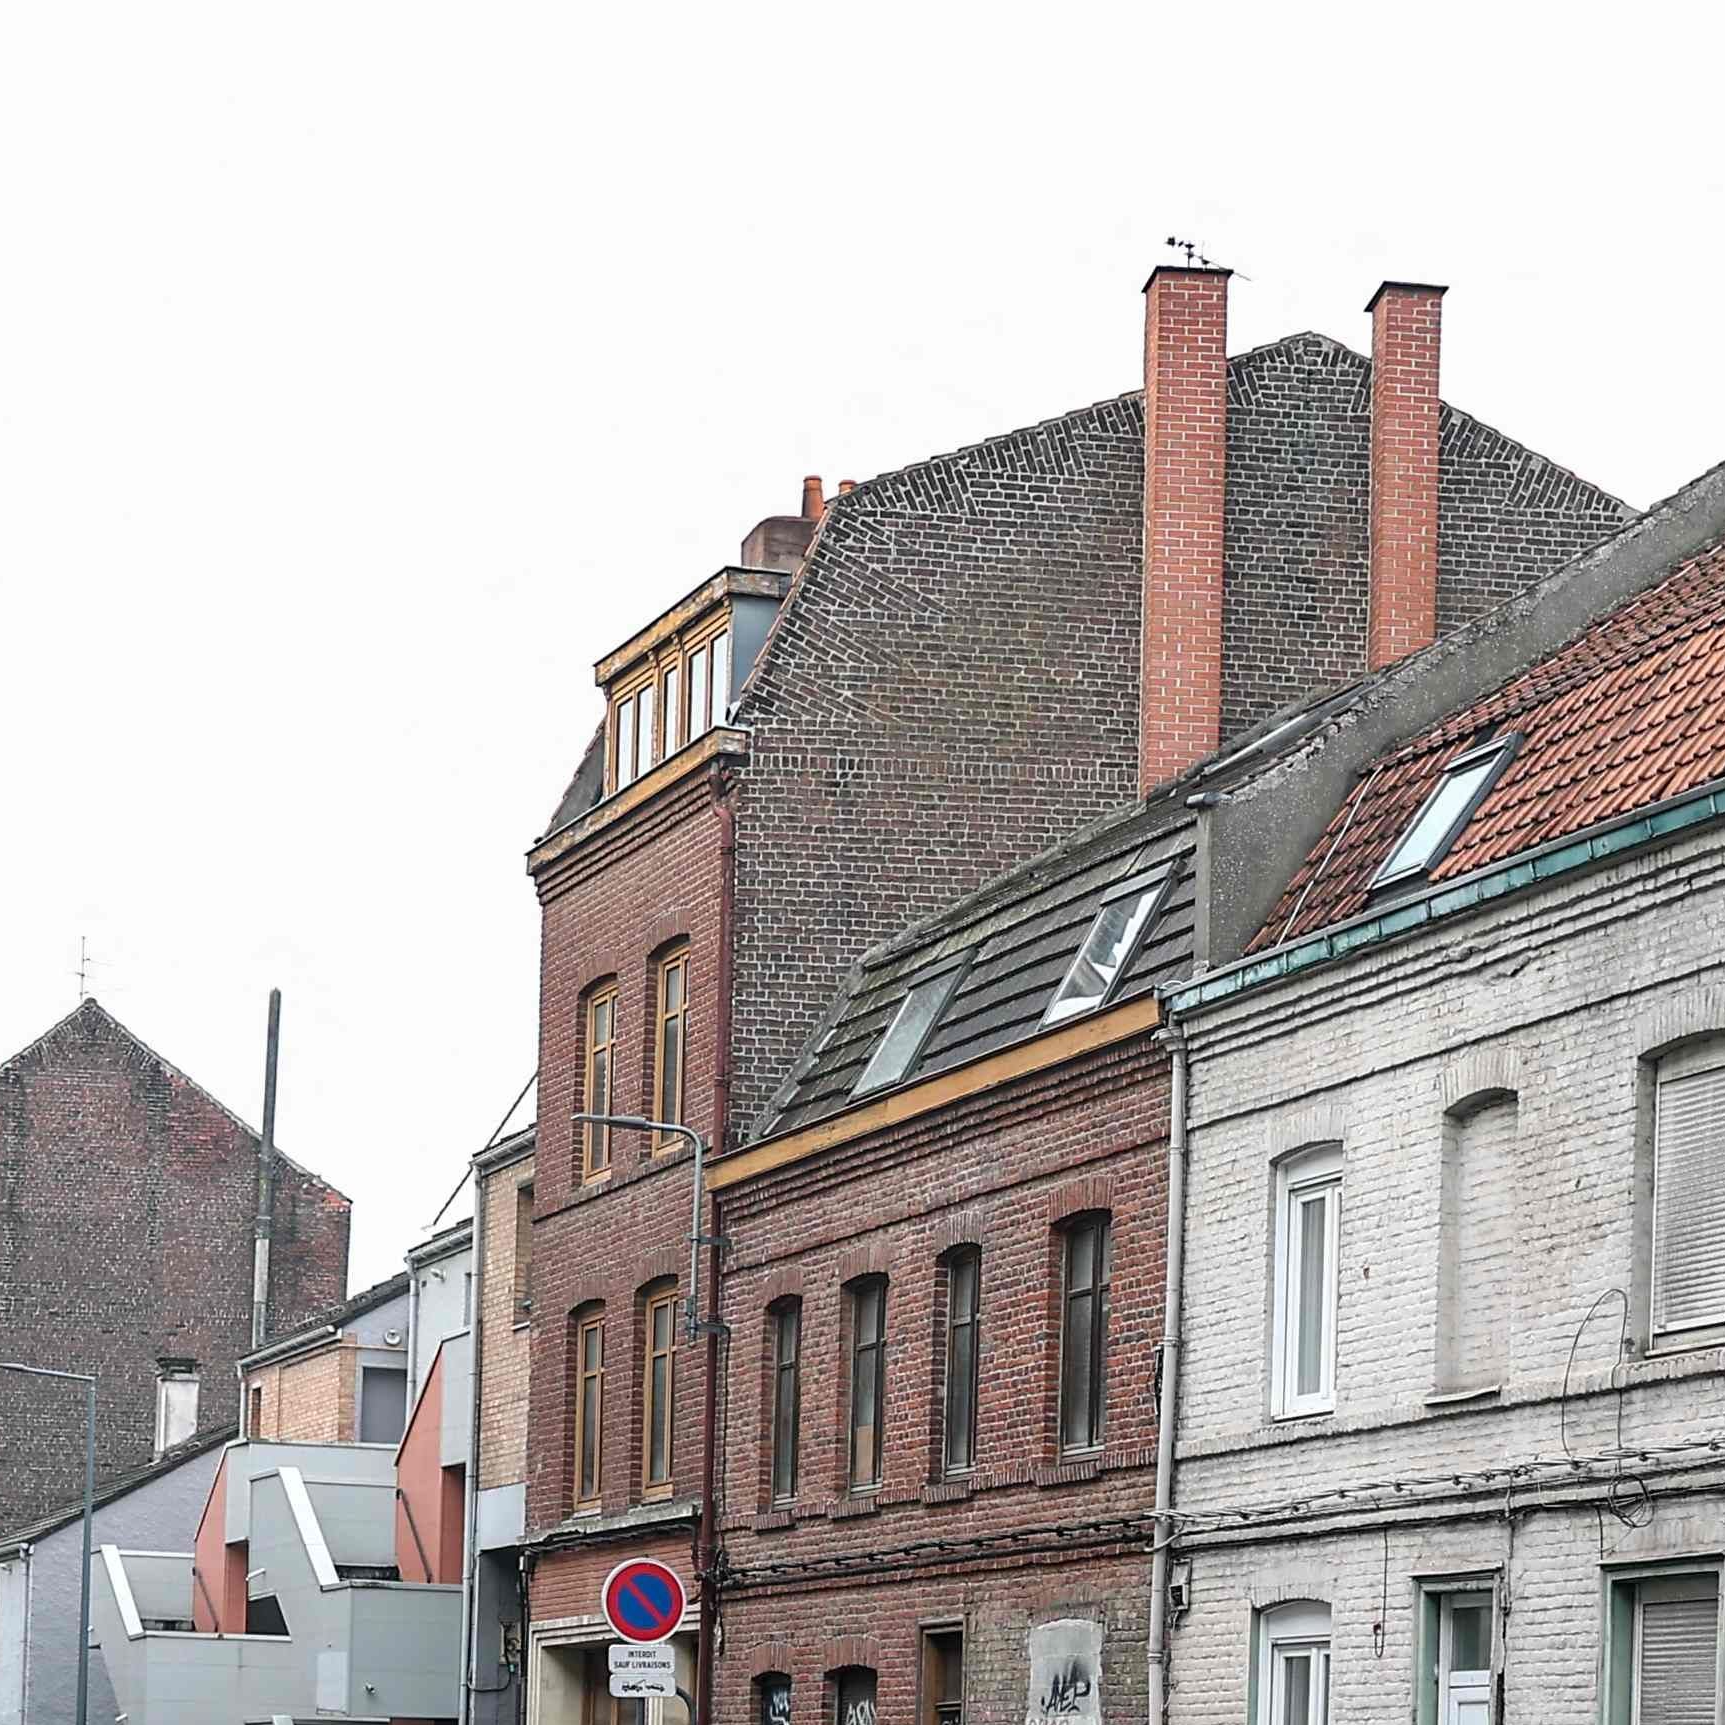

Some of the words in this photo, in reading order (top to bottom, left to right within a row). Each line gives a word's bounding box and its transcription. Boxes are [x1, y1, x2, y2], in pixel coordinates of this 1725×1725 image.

[628, 1650, 656, 1658] INTERDIT
[614, 1661, 630, 1669] SAUF
[631, 1661, 671, 1669] LIVRAISONS
